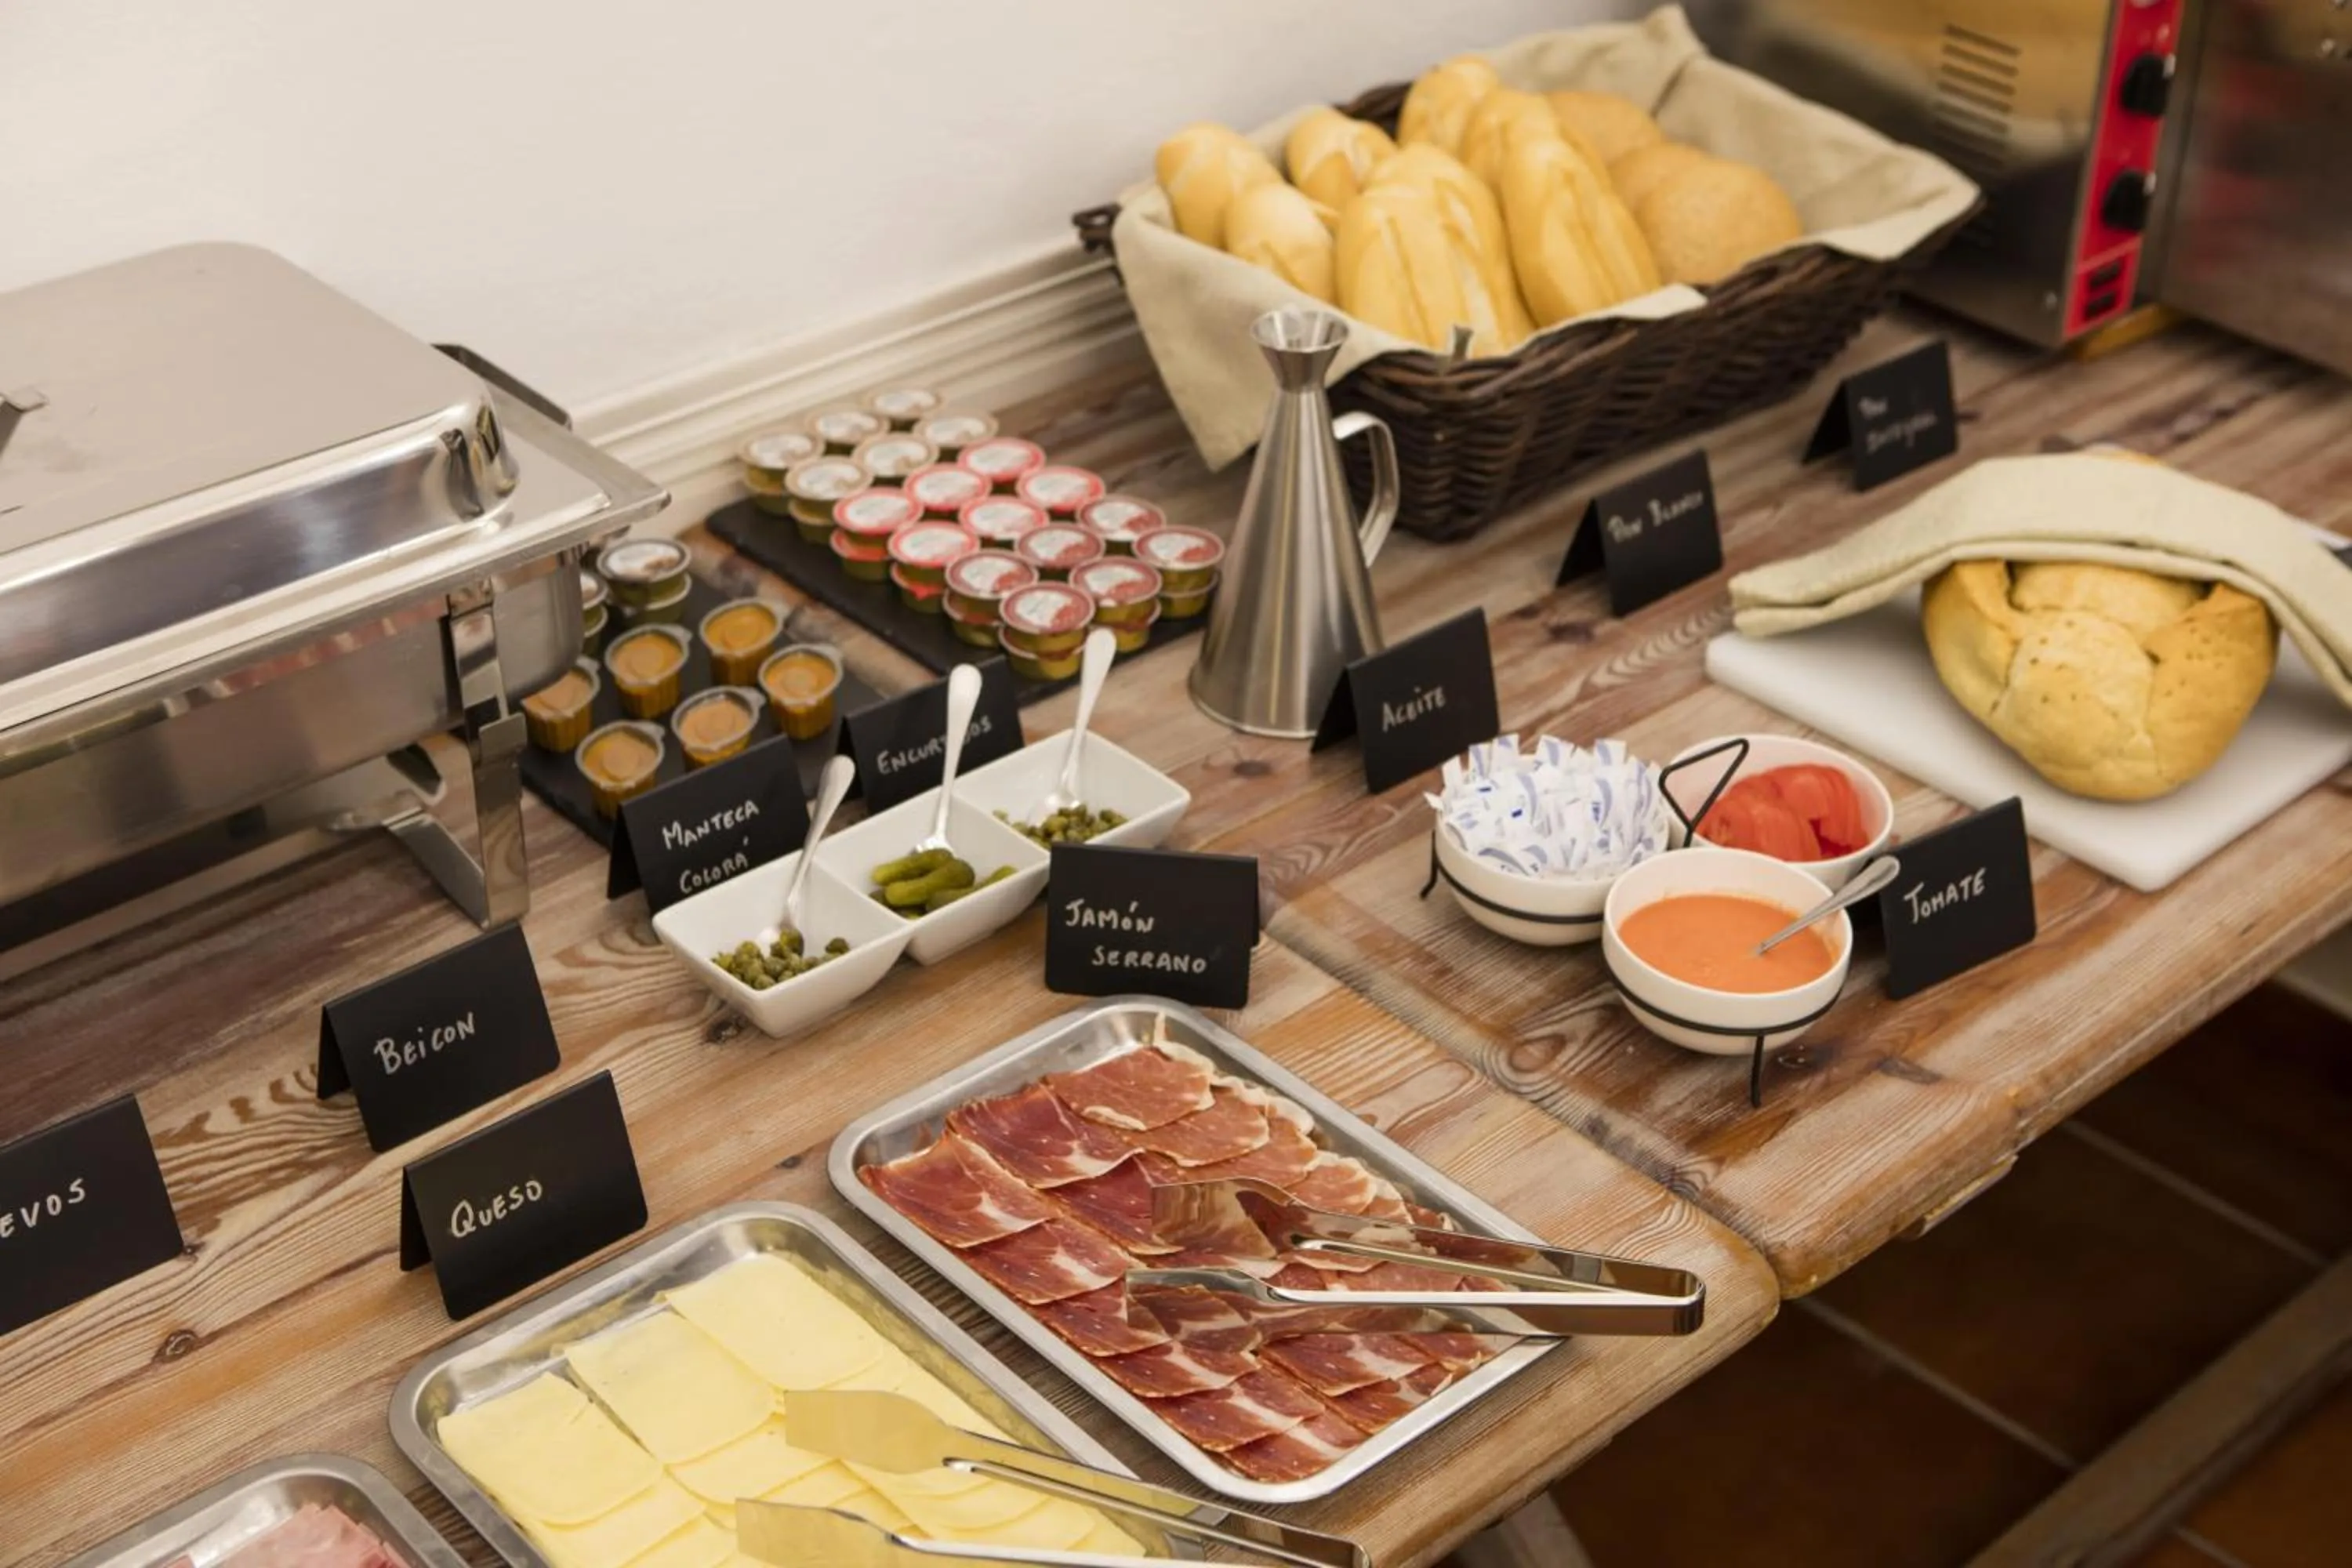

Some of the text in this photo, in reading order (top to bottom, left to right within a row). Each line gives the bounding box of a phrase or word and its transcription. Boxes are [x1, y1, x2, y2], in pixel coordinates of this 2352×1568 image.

[877, 714, 993, 775] ENCUROS
[662, 799, 760, 851] MANTECA
[1065, 898, 1155, 934] JAMÓN
[1903, 866, 1987, 924] TOMATE
[1092, 945, 1208, 975] SERRANO
[451, 1179, 543, 1238] QUESO
